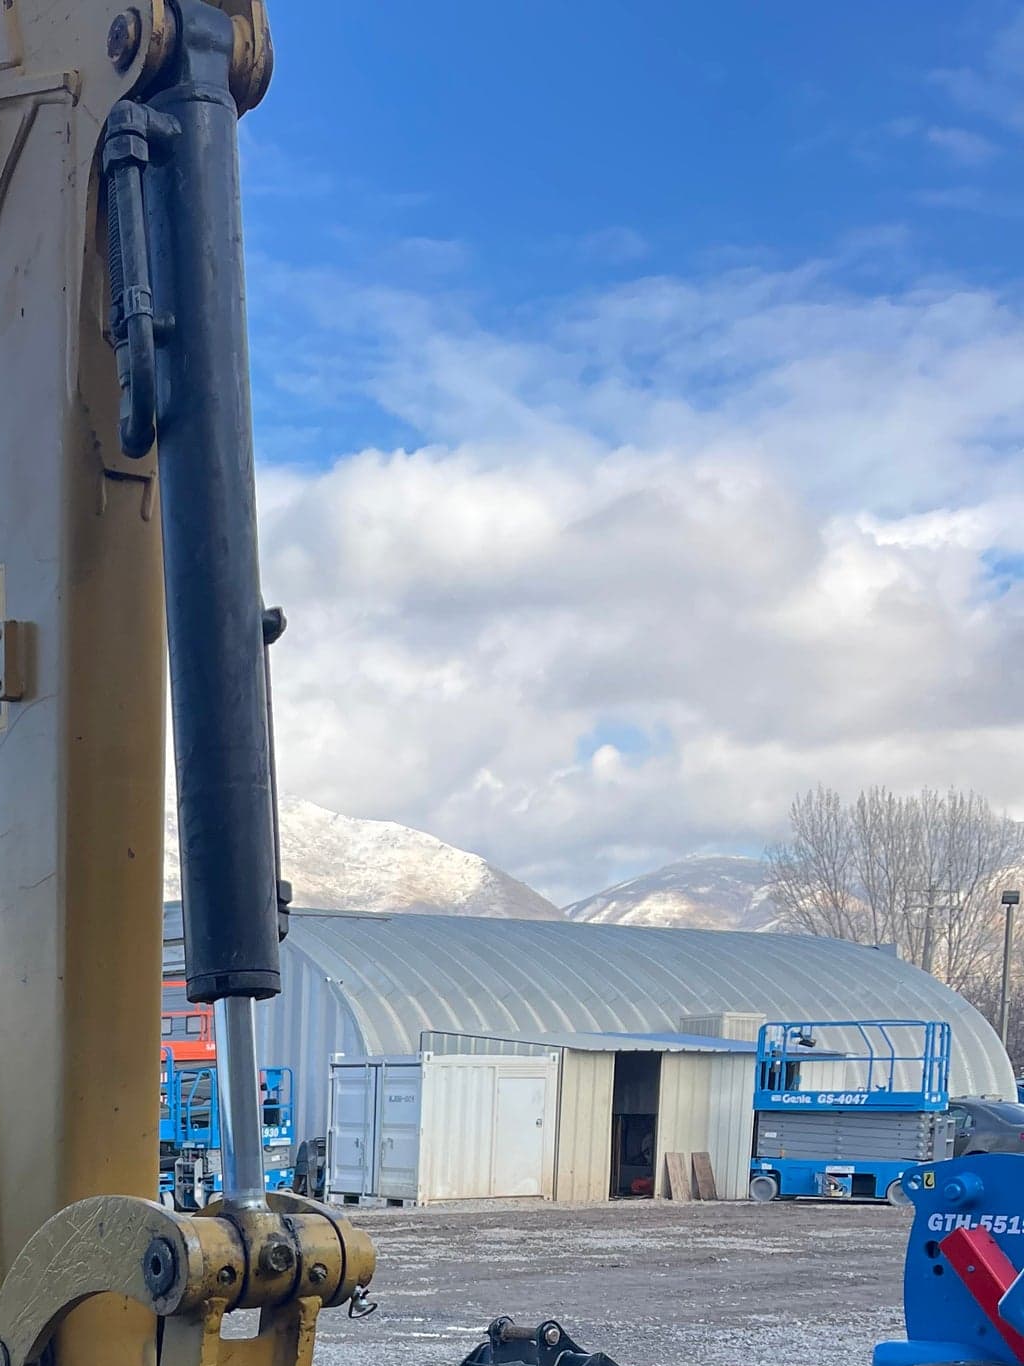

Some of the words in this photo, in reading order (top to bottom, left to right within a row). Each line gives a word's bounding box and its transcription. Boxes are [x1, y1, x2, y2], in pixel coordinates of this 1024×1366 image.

[782, 1093, 812, 1104] Genie
[817, 1094, 869, 1105] GS-4047
[927, 1212, 1024, 1235] GTH-551
